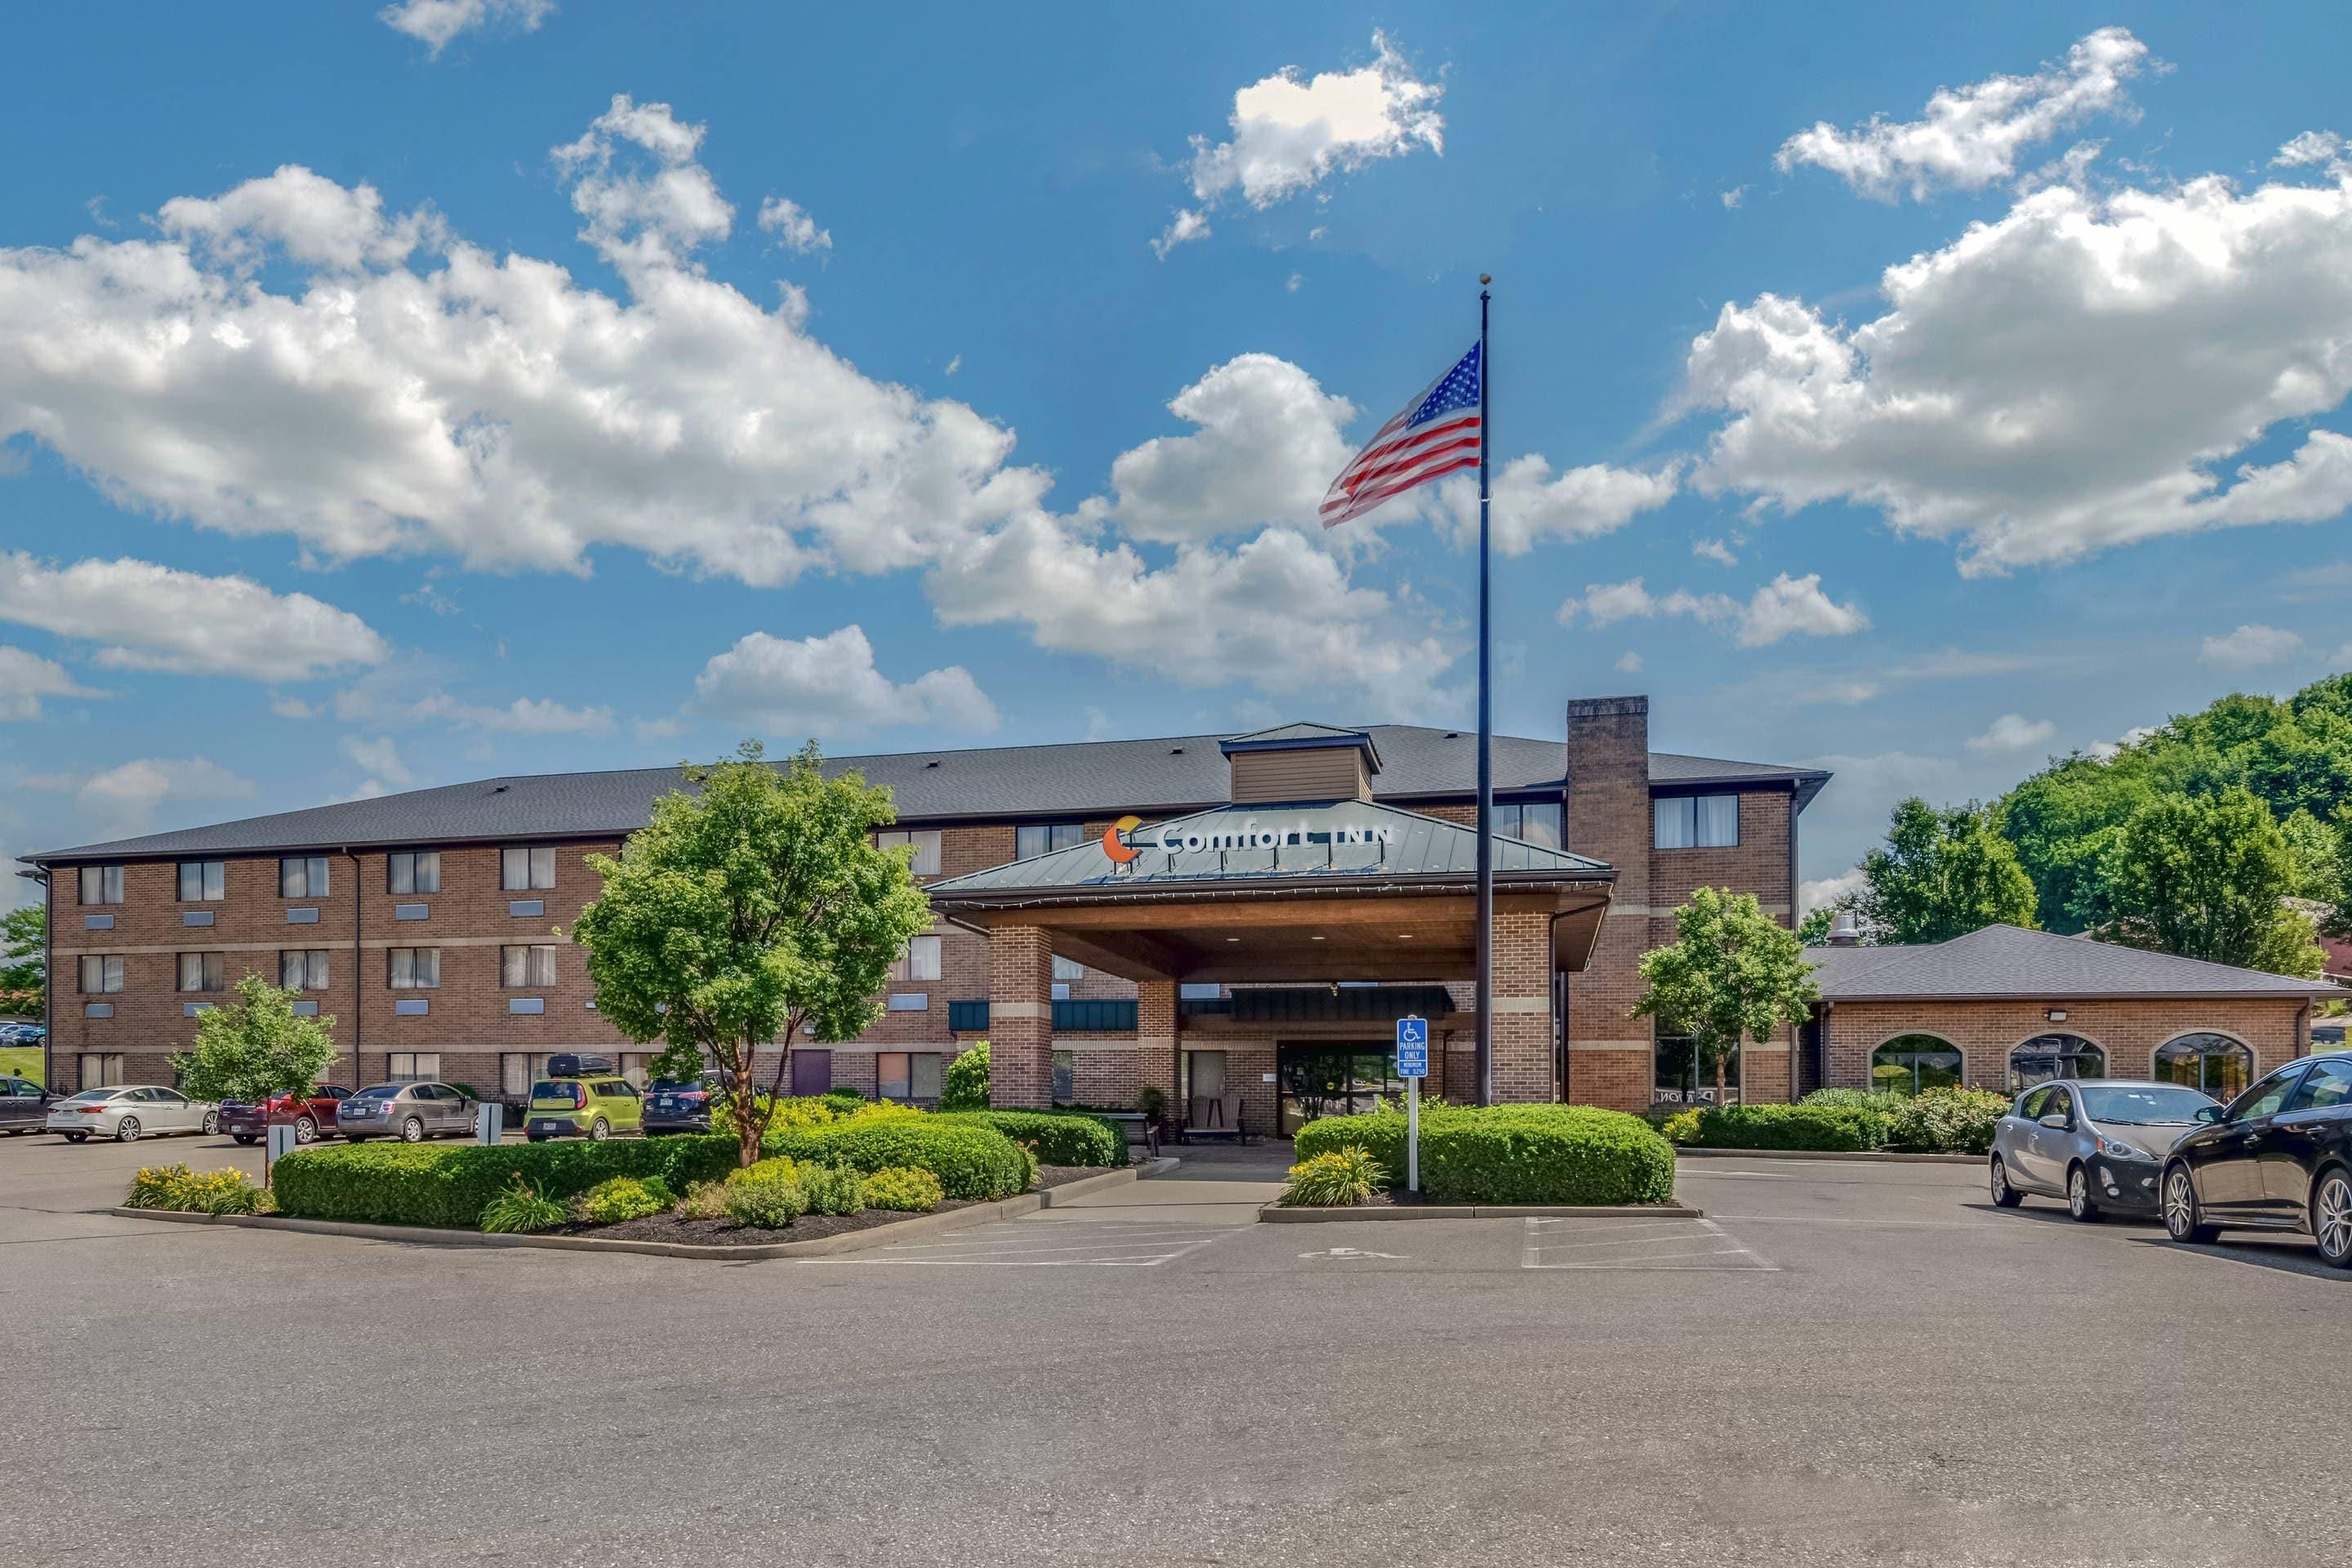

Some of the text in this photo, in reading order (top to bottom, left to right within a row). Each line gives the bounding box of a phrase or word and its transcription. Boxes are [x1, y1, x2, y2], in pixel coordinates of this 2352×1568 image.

[1156, 818, 1394, 855] Comfort INN
[1399, 1041, 1425, 1050] PARKING
[1405, 1051, 1420, 1059] ONLY
